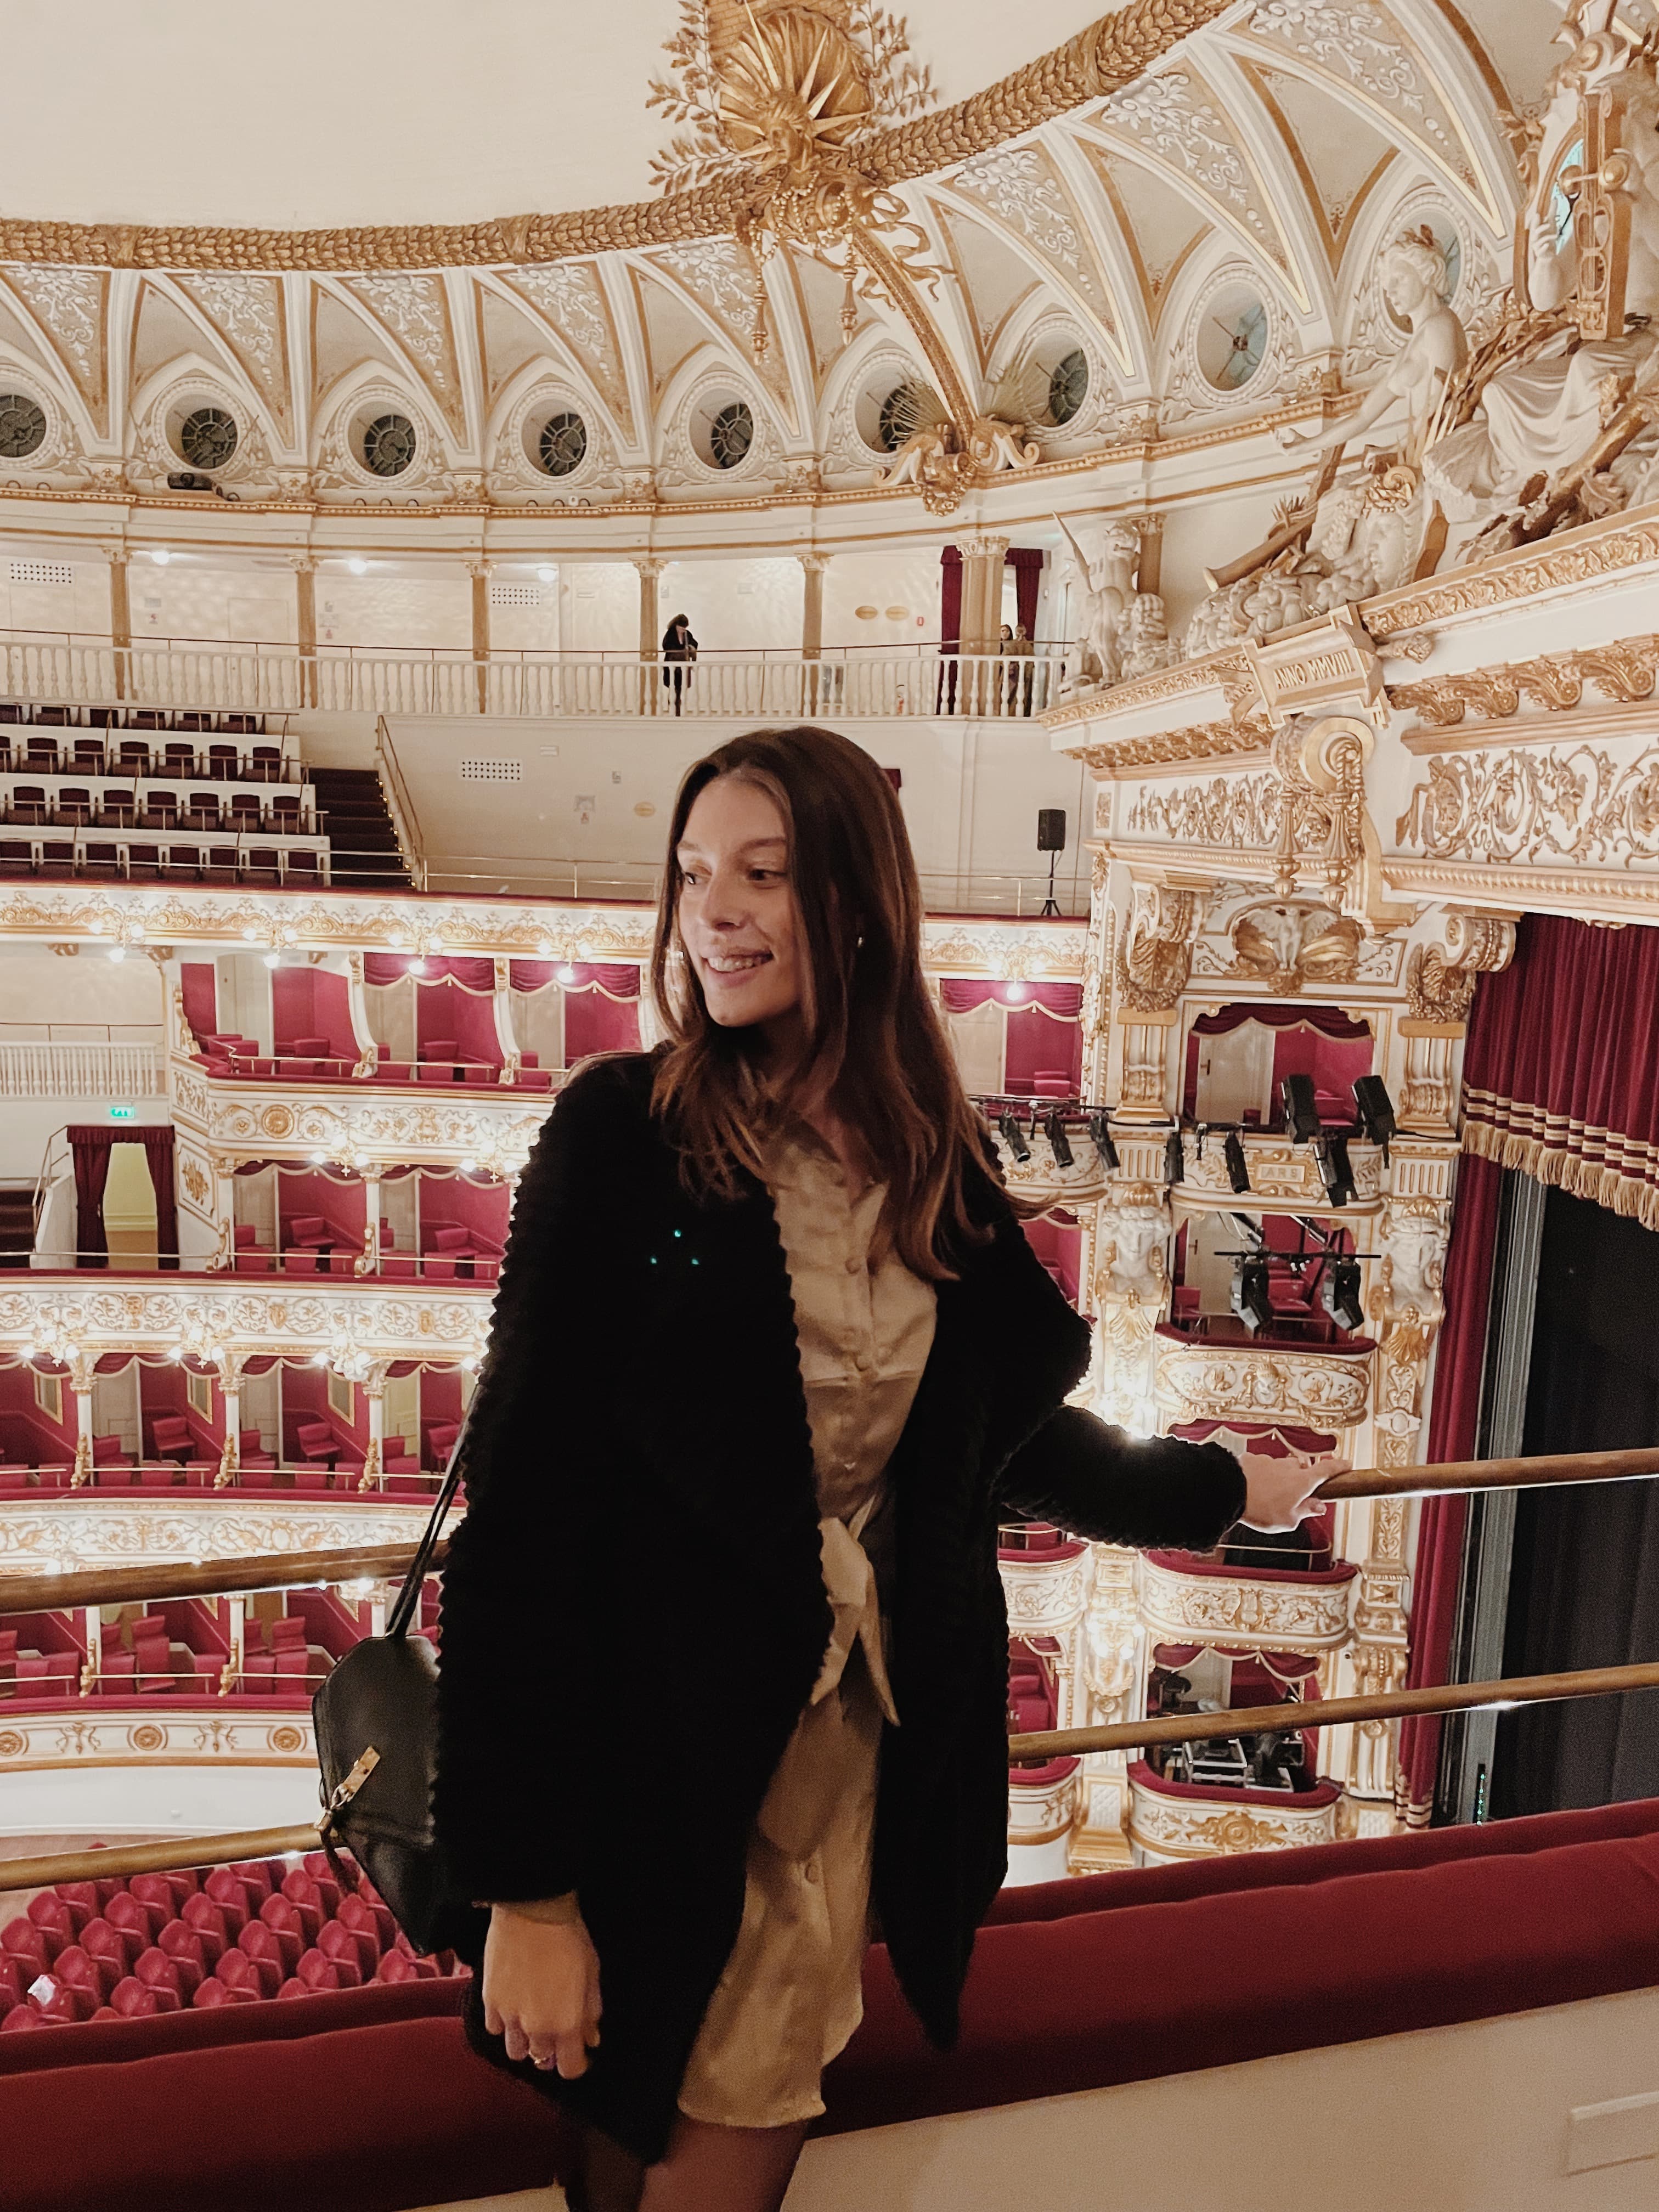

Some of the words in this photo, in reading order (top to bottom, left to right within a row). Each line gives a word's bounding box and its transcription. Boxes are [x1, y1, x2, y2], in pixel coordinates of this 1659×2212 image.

[1273, 664, 1307, 690] ANNO
[1308, 650, 1355, 681] MMVIII
[1265, 1167, 1298, 1178] ARS
